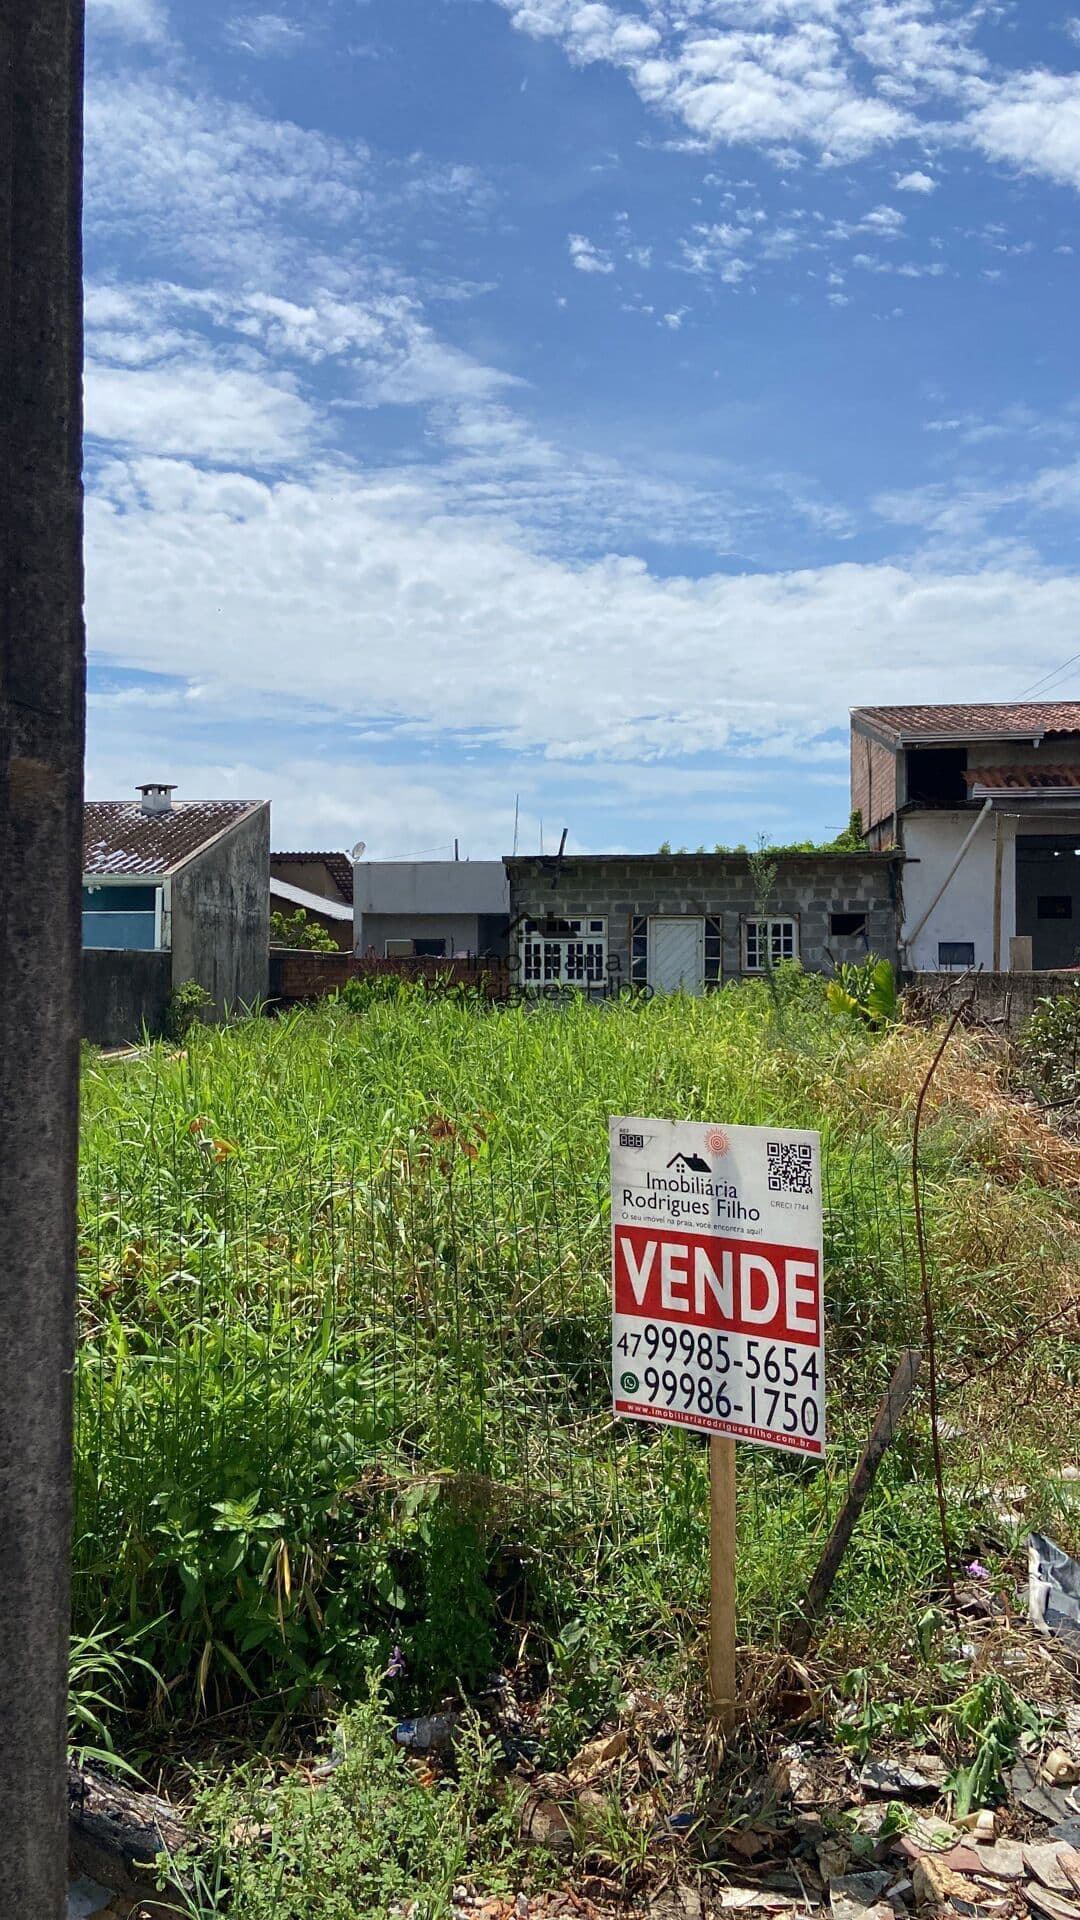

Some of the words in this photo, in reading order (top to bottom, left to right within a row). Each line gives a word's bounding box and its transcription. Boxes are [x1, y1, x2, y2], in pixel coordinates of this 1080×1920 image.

[646, 1172, 738, 1199] Imobiliária
[621, 1211, 628, 1219] O
[713, 1224, 745, 1233] encontra
[623, 1190, 709, 1217] Rodrigues
[717, 1199, 760, 1221] Filho
[770, 1200, 792, 1209] CRECI
[620, 1237, 817, 1334] VENDE
[617, 1332, 641, 1357] 47
[644, 1324, 819, 1391] 99985-5654
[644, 1367, 819, 1436] 99986-1750
[627, 1404, 811, 1447] www.imobiliariarodriguesfilho.com.br
